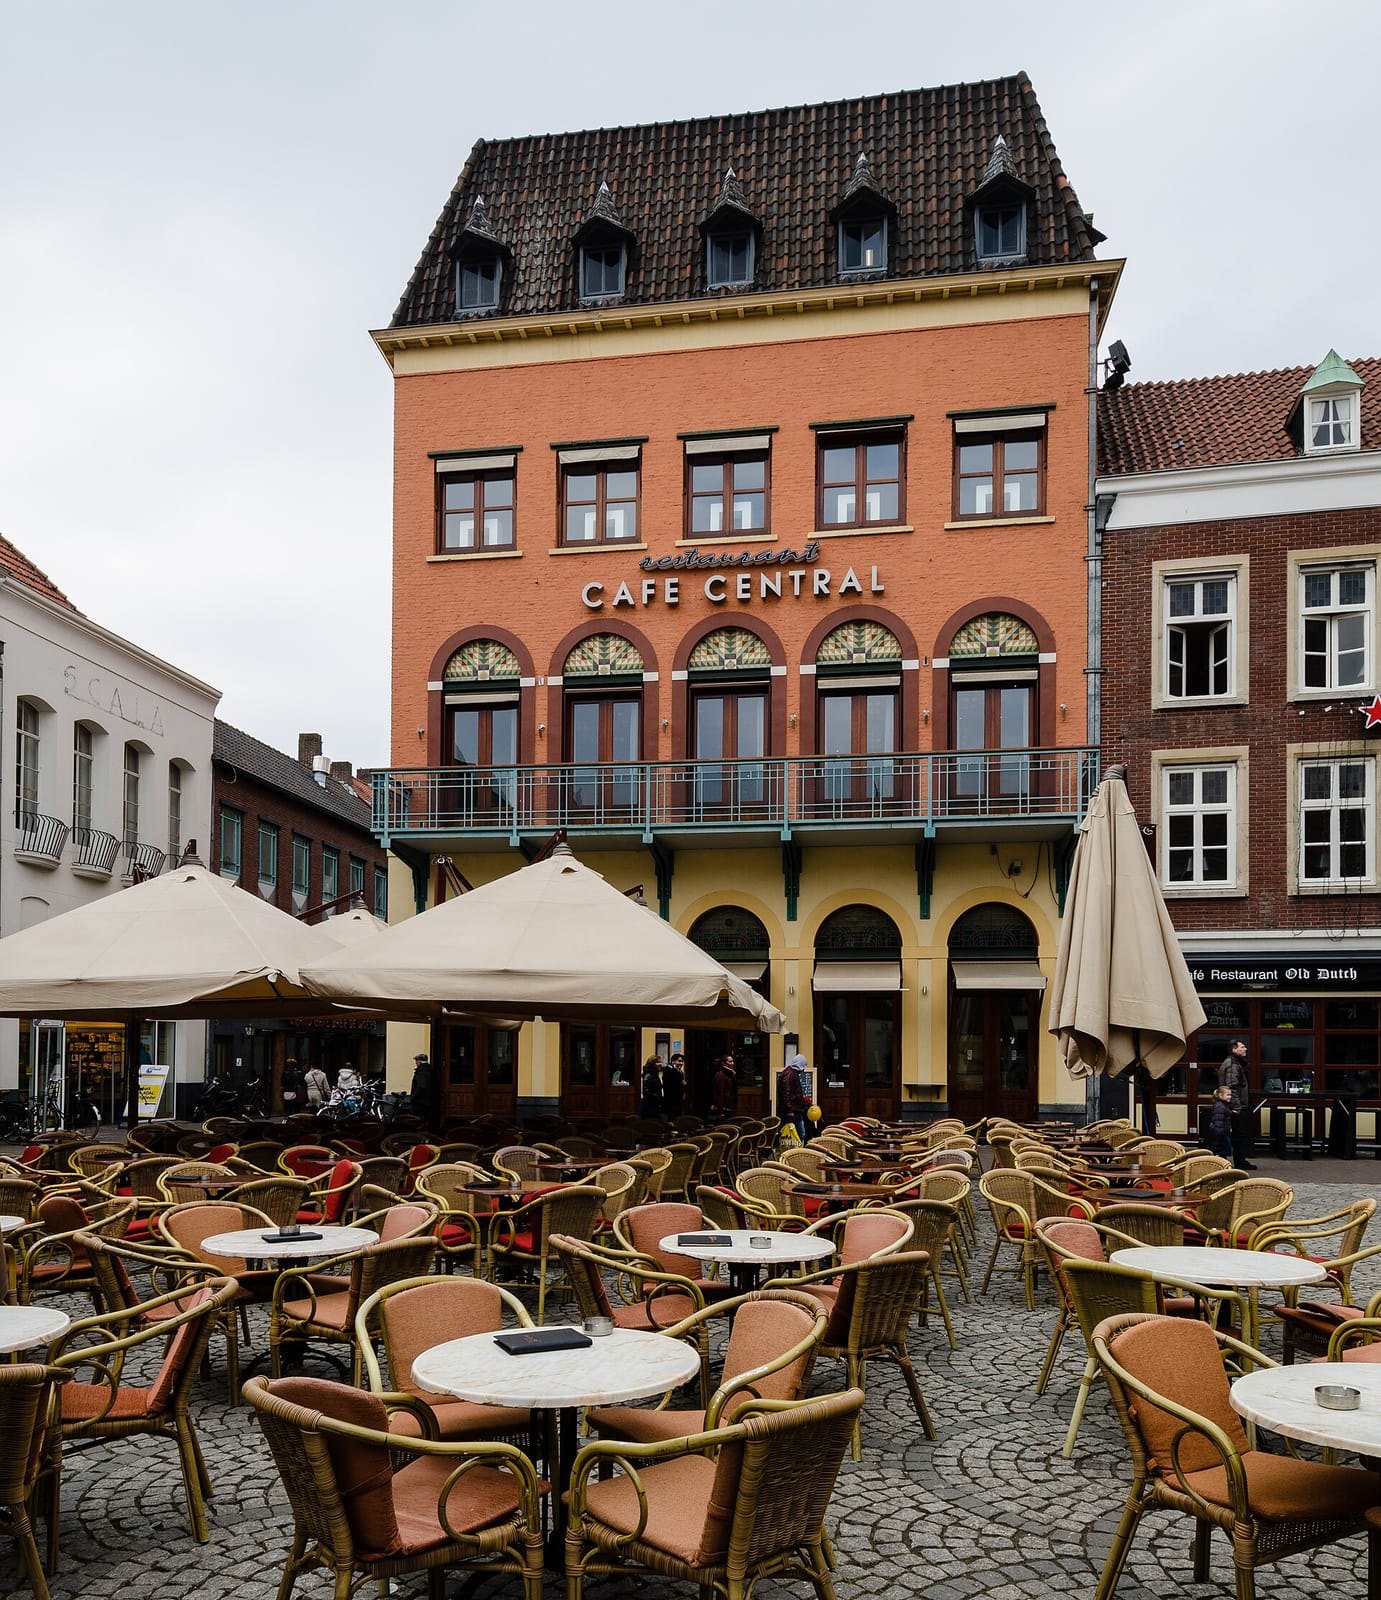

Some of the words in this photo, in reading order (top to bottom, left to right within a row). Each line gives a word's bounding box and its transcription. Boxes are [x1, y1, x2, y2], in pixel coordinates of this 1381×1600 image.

[639, 541, 820, 571] restaurant
[581, 577, 679, 609] CAFE
[704, 565, 885, 602] CENTRAL
[1187, 969, 1205, 981] fé
[1210, 968, 1279, 981] Restaurant
[1285, 967, 1311, 980] Old
[1317, 967, 1358, 981] Dutch
